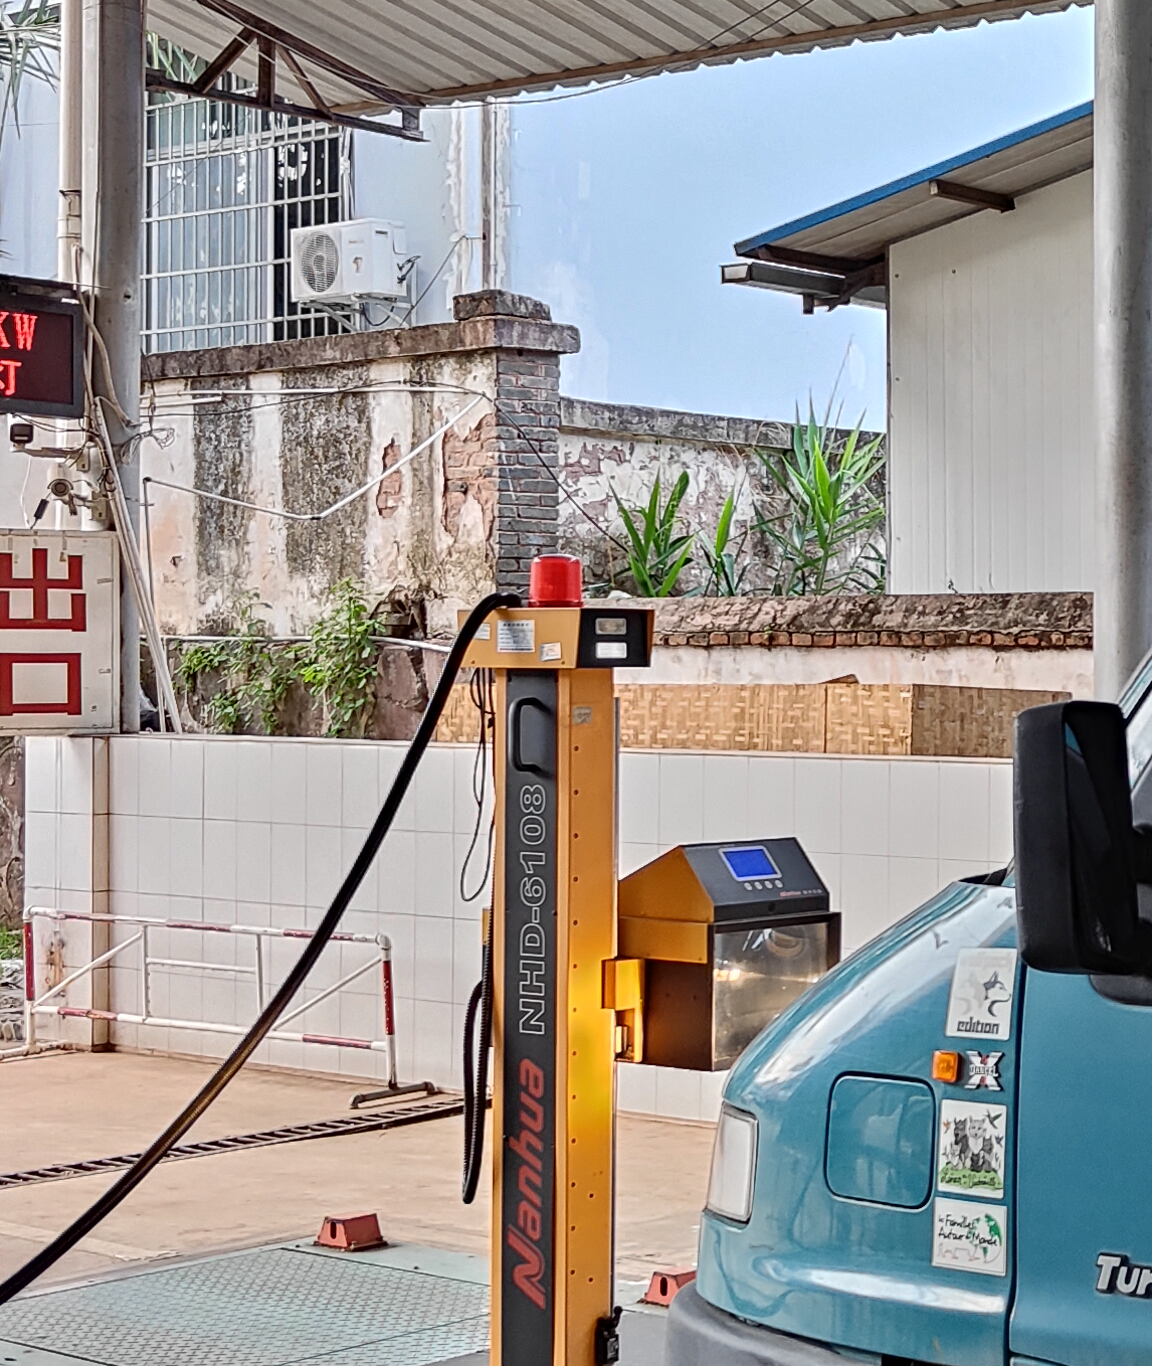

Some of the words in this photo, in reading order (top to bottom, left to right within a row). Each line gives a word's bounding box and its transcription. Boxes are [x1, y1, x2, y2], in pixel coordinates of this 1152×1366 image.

[0, 548, 87, 715] 出口
[518, 783, 547, 1036] NHD-6108
[957, 1016, 1000, 1035] edition
[506, 1057, 547, 1310] Nanhua
